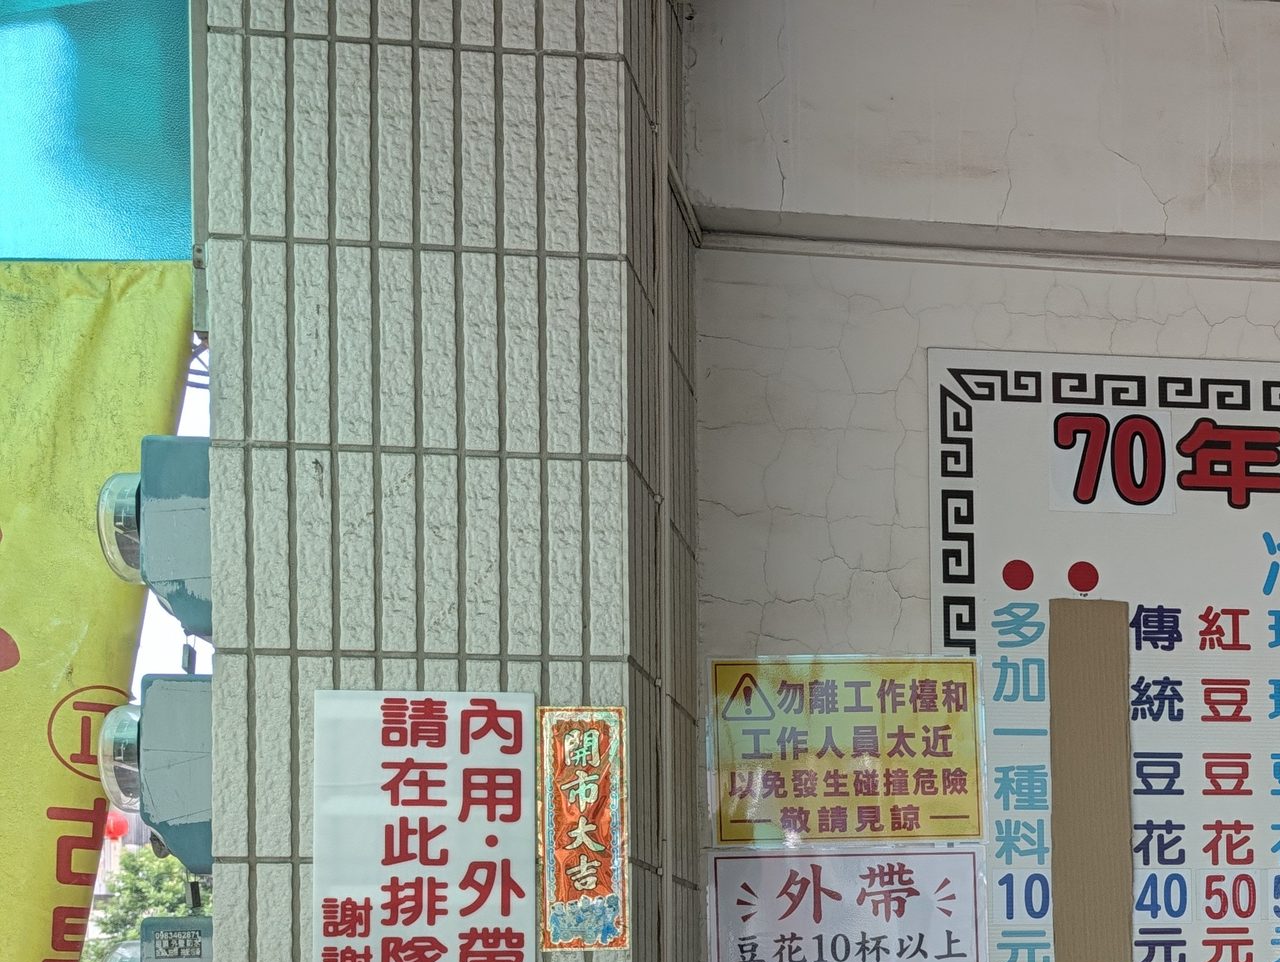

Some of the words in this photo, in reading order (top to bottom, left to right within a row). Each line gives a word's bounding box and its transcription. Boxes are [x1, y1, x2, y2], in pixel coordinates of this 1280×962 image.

[776, 679, 968, 715] 勿離工作檯和
[741, 725, 954, 760] 工作人員太近
[728, 767, 969, 799] 以免發生碰撞危險
[561, 728, 606, 892] 開市大吉
[775, 862, 921, 925] 外帶
